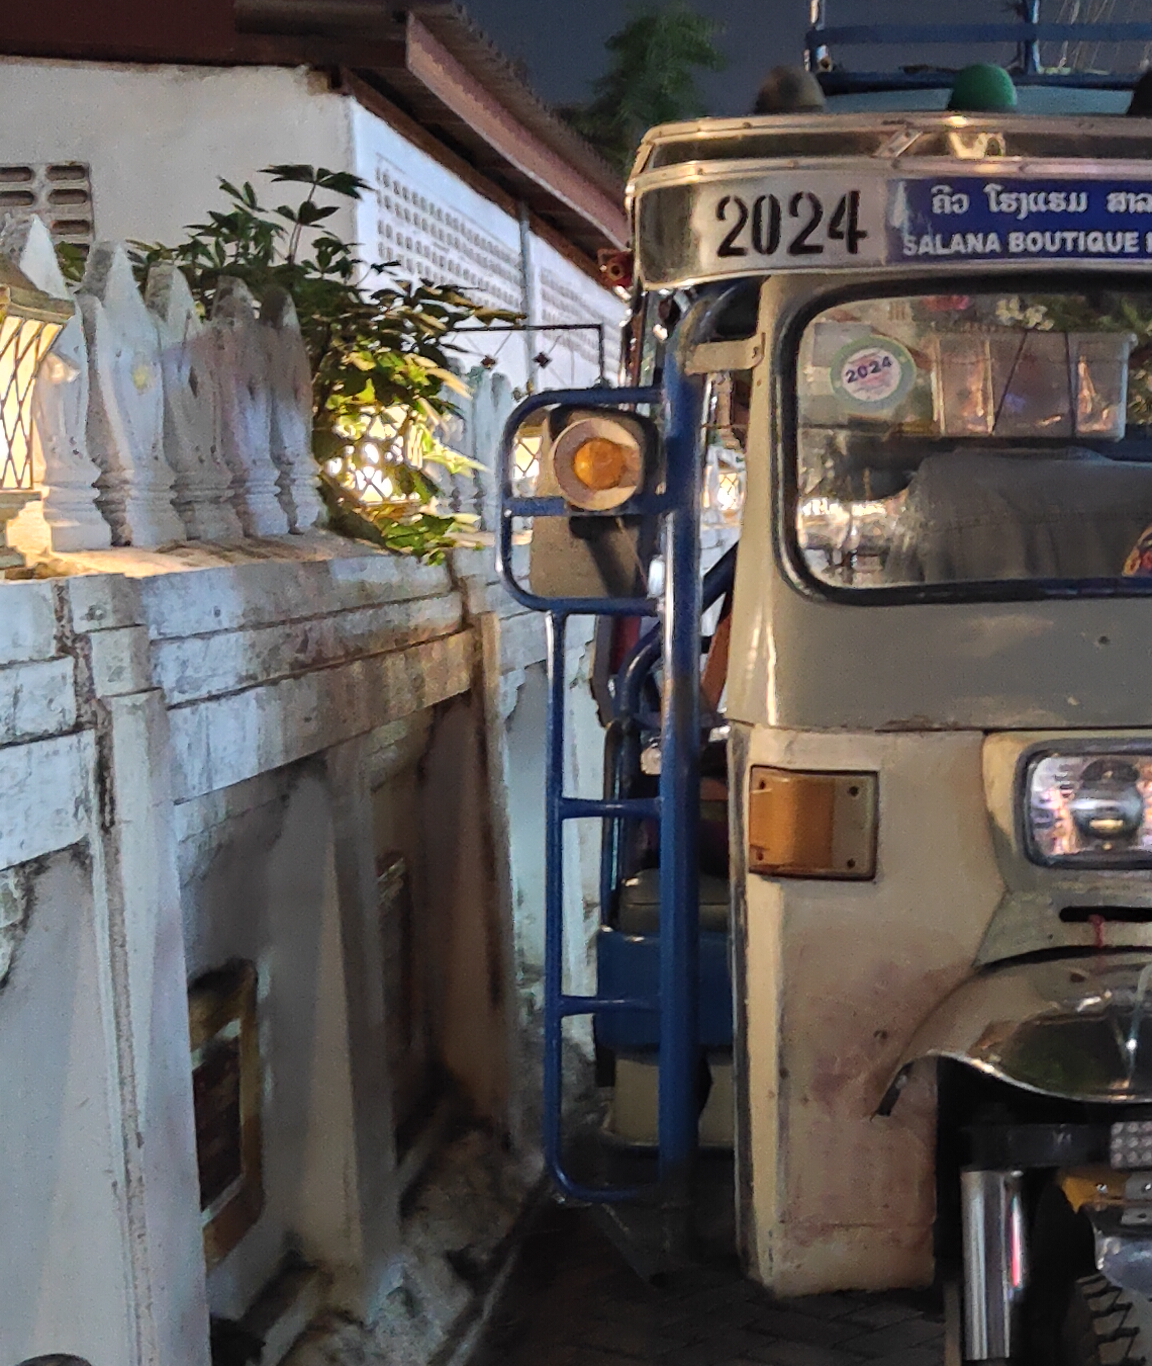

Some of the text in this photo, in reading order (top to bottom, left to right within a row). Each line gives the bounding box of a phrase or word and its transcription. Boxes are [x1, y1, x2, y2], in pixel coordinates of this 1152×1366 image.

[984, 183, 1088, 220] ໂຮງແຮມ
[716, 190, 868, 257] 2024
[902, 232, 1001, 257] SALANA
[1008, 229, 1140, 255] BOUTIQUE
[845, 356, 892, 384] 2024
